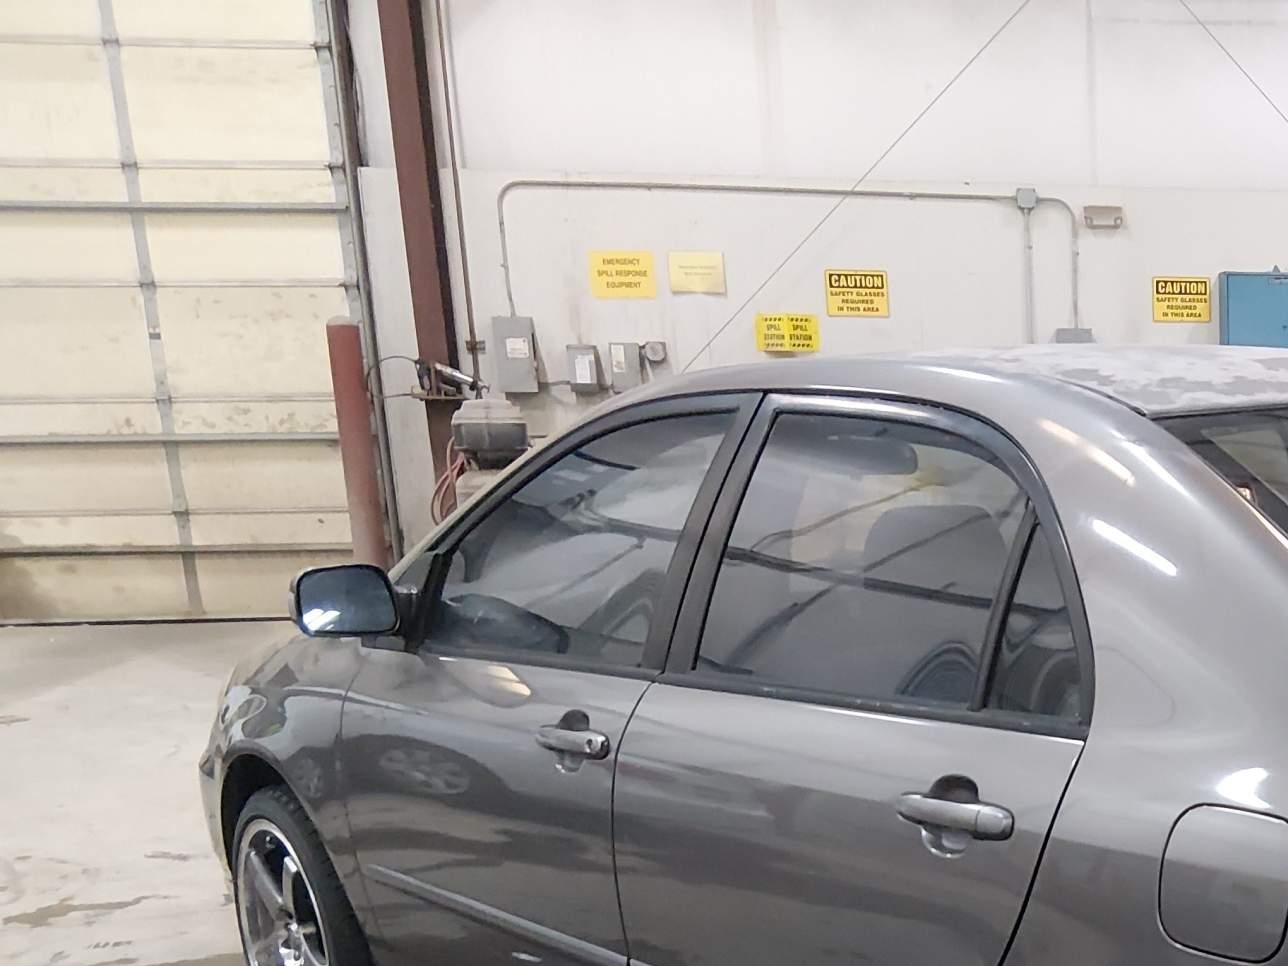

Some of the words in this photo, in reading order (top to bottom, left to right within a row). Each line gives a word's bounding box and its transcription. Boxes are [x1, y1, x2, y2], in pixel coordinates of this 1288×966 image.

[602, 257, 641, 266] EMERGENCY
[596, 269, 614, 277] SPILL
[606, 281, 641, 289] EQUIPMENT
[831, 274, 882, 288] CAUTION
[1158, 281, 1206, 294] CAUTION
[766, 323, 782, 331] SPILL
[792, 324, 809, 332] SPILL
[789, 333, 813, 341] STATION
